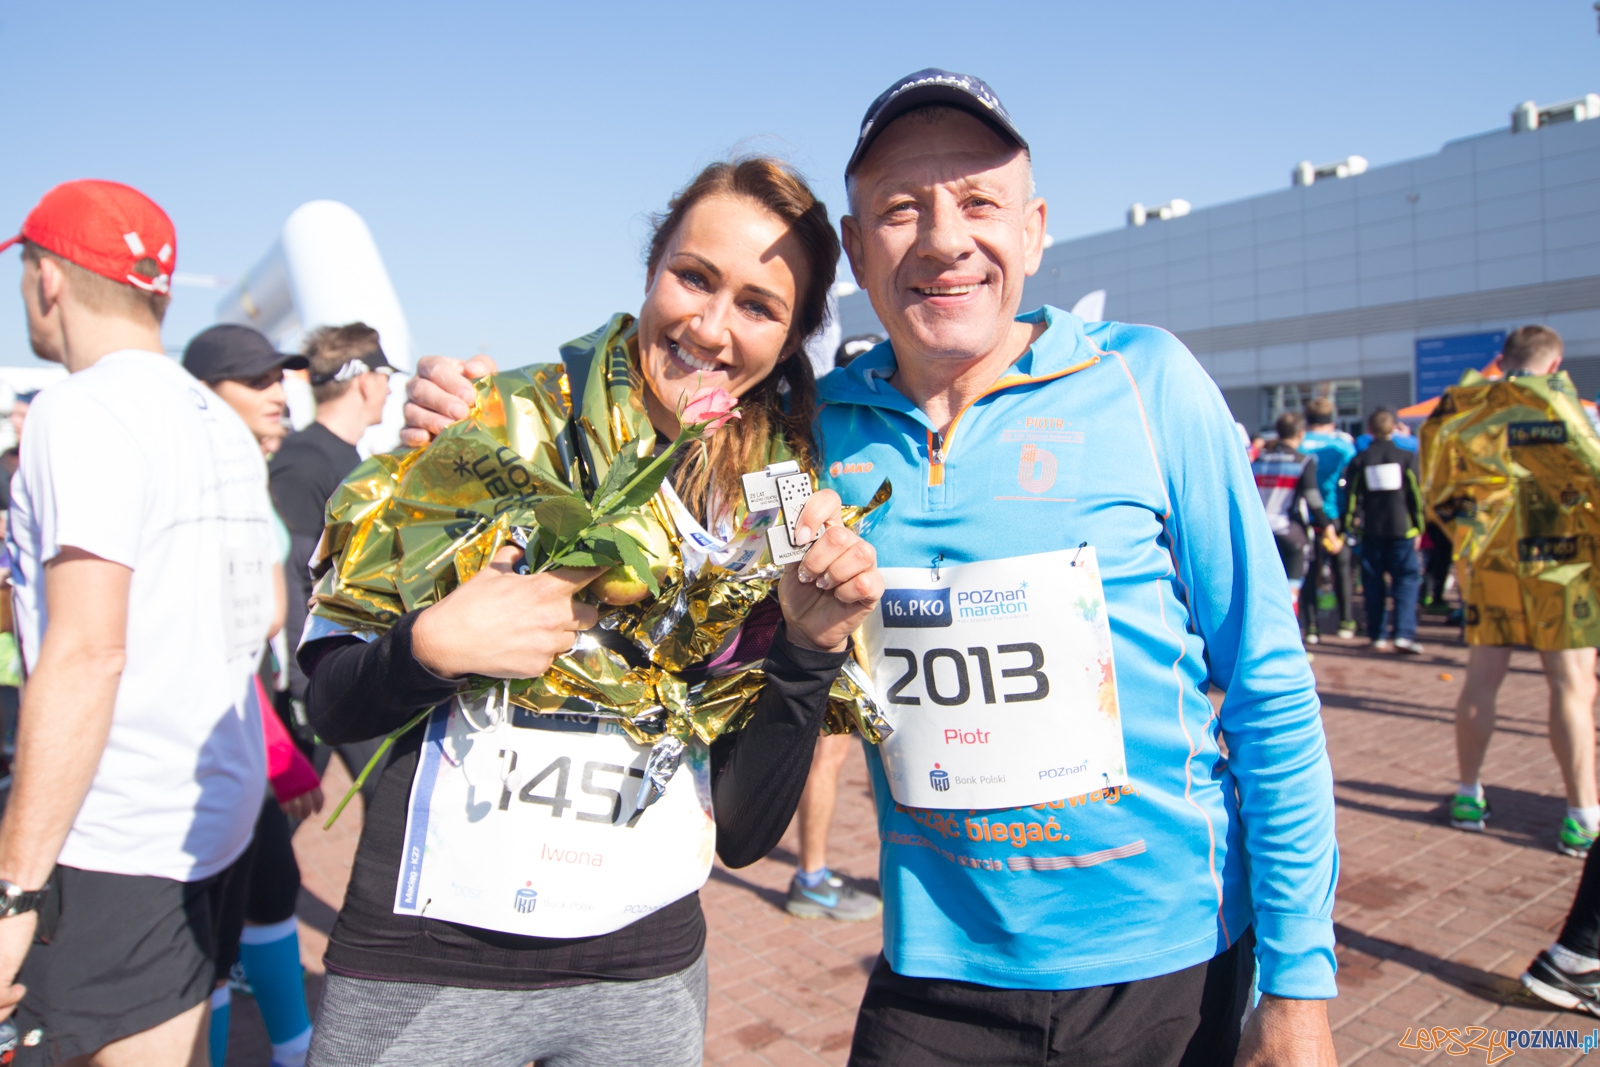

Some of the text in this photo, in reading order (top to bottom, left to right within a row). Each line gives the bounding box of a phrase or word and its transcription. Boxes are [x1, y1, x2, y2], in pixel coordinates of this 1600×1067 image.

[1025, 417, 1064, 429] PIOTR
[842, 462, 874, 474] JAKO
[886, 599, 944, 616] 16. PKO
[960, 601, 1028, 618] maraton
[884, 641, 1050, 707] 2013
[944, 728, 991, 745] Piotr
[955, 773, 1006, 785] Bank Polski
[965, 816, 1071, 848] biegać.
[411, 845, 420, 866] K27
[541, 843, 603, 867] Iwona
[958, 854, 1002, 871] starcie
[543, 898, 596, 913] Bank Polski
